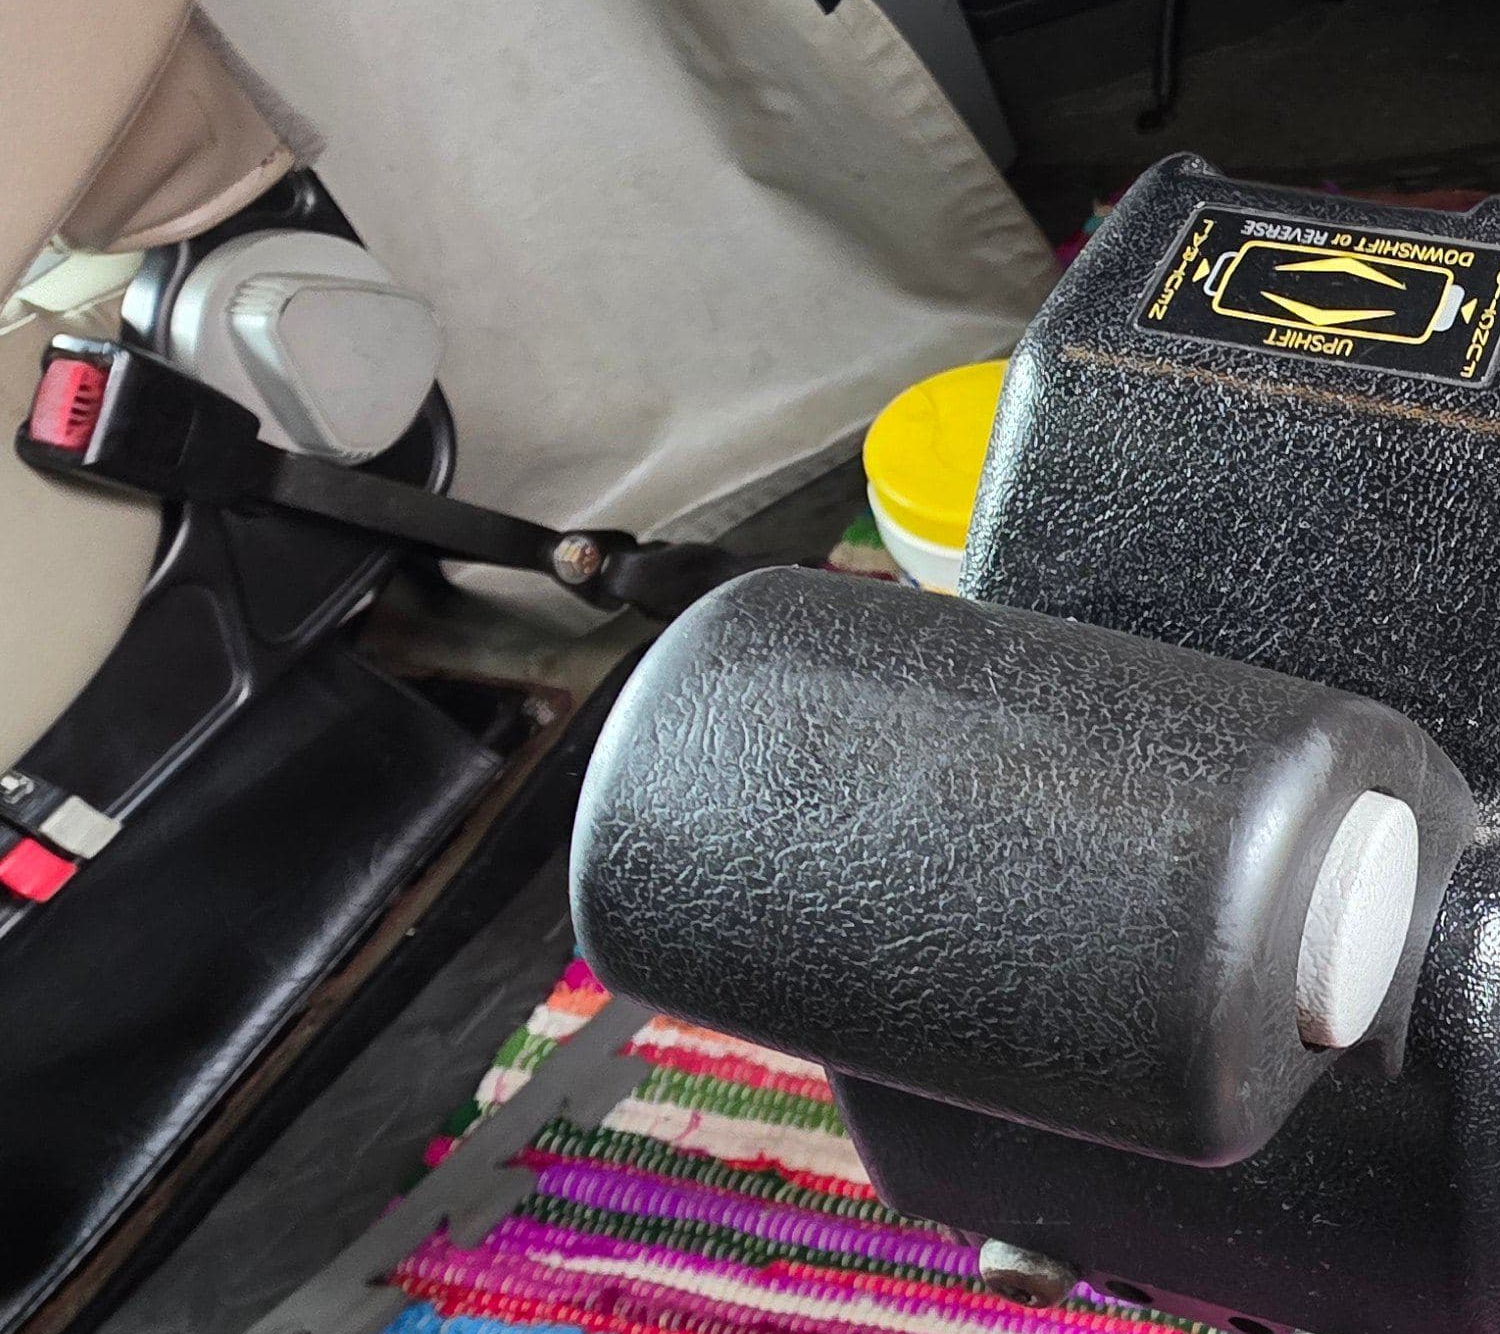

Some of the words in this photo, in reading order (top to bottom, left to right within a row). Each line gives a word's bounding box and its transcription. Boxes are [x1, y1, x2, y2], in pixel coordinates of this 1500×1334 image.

[1240, 219, 1329, 246] REVERSE
[1331, 233, 1352, 247] or
[1353, 236, 1475, 268] DOWNSHIFT
[1148, 218, 1214, 320] NEUTRAL
[1262, 328, 1354, 357] UPSHIFT
